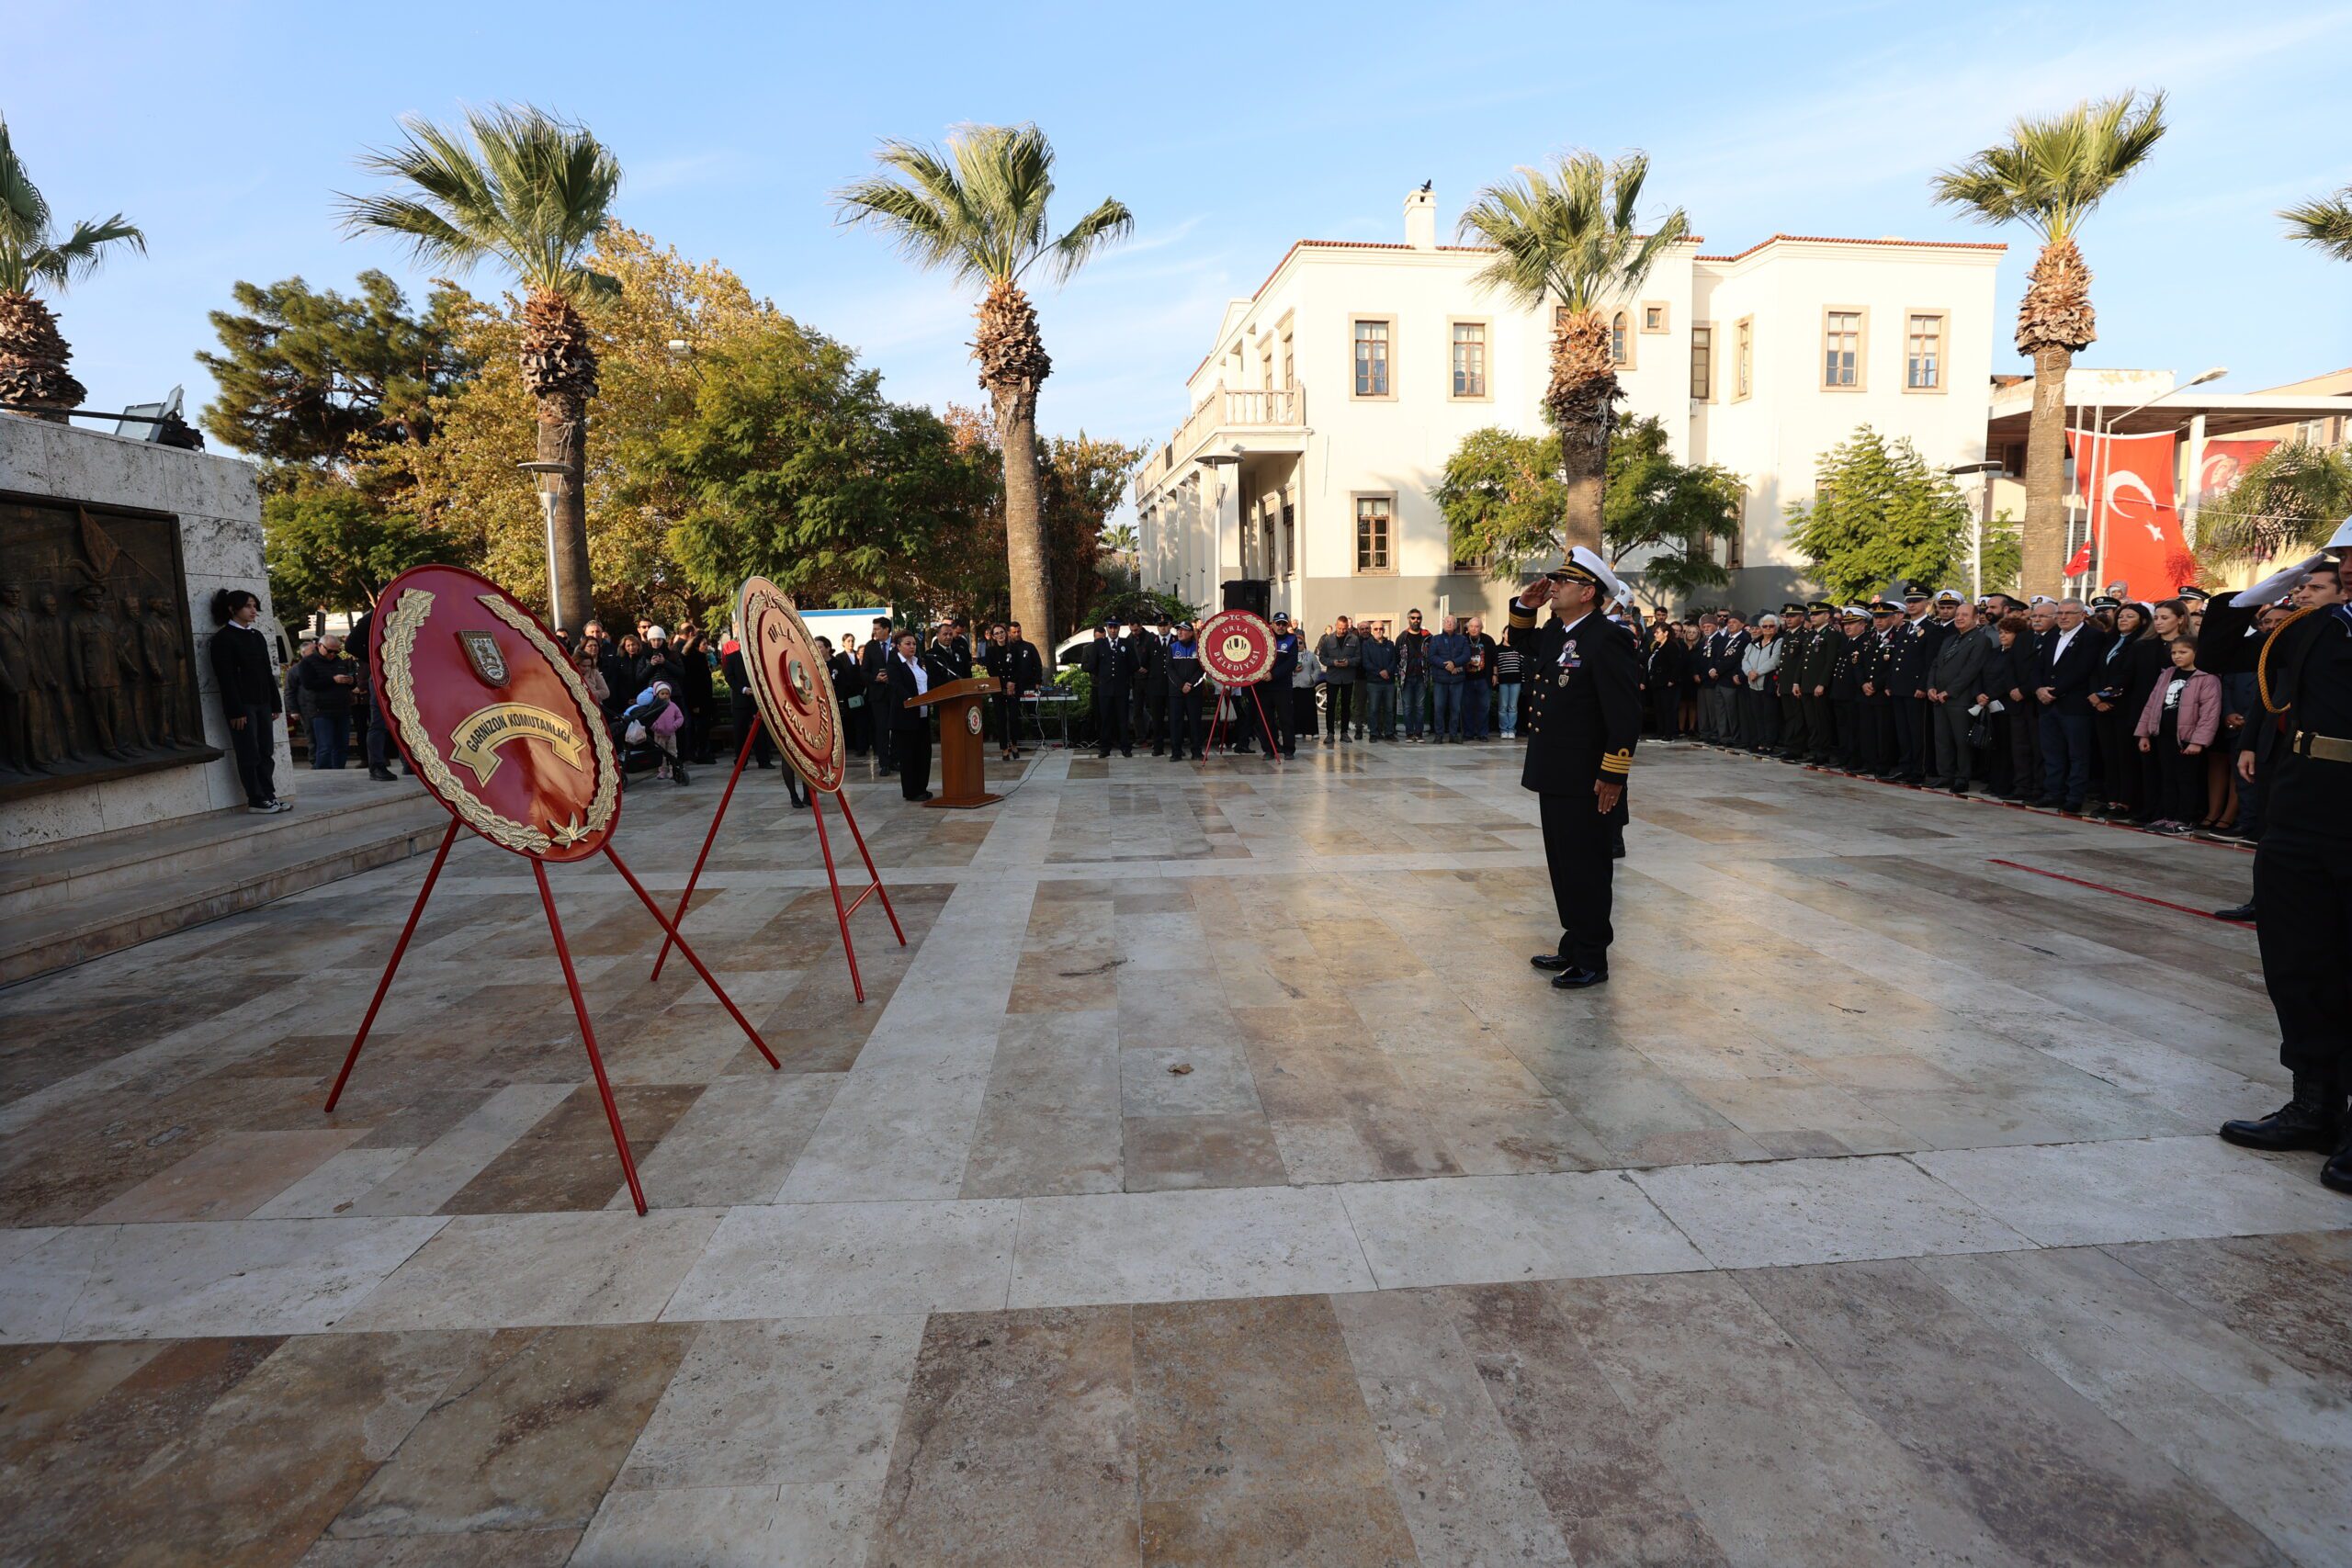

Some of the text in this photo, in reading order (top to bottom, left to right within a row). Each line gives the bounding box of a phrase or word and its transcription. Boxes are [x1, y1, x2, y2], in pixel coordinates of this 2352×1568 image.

[1222, 626, 1249, 634] URLA
[467, 714, 570, 752] GARNİZON KOMUTANLIĞI
